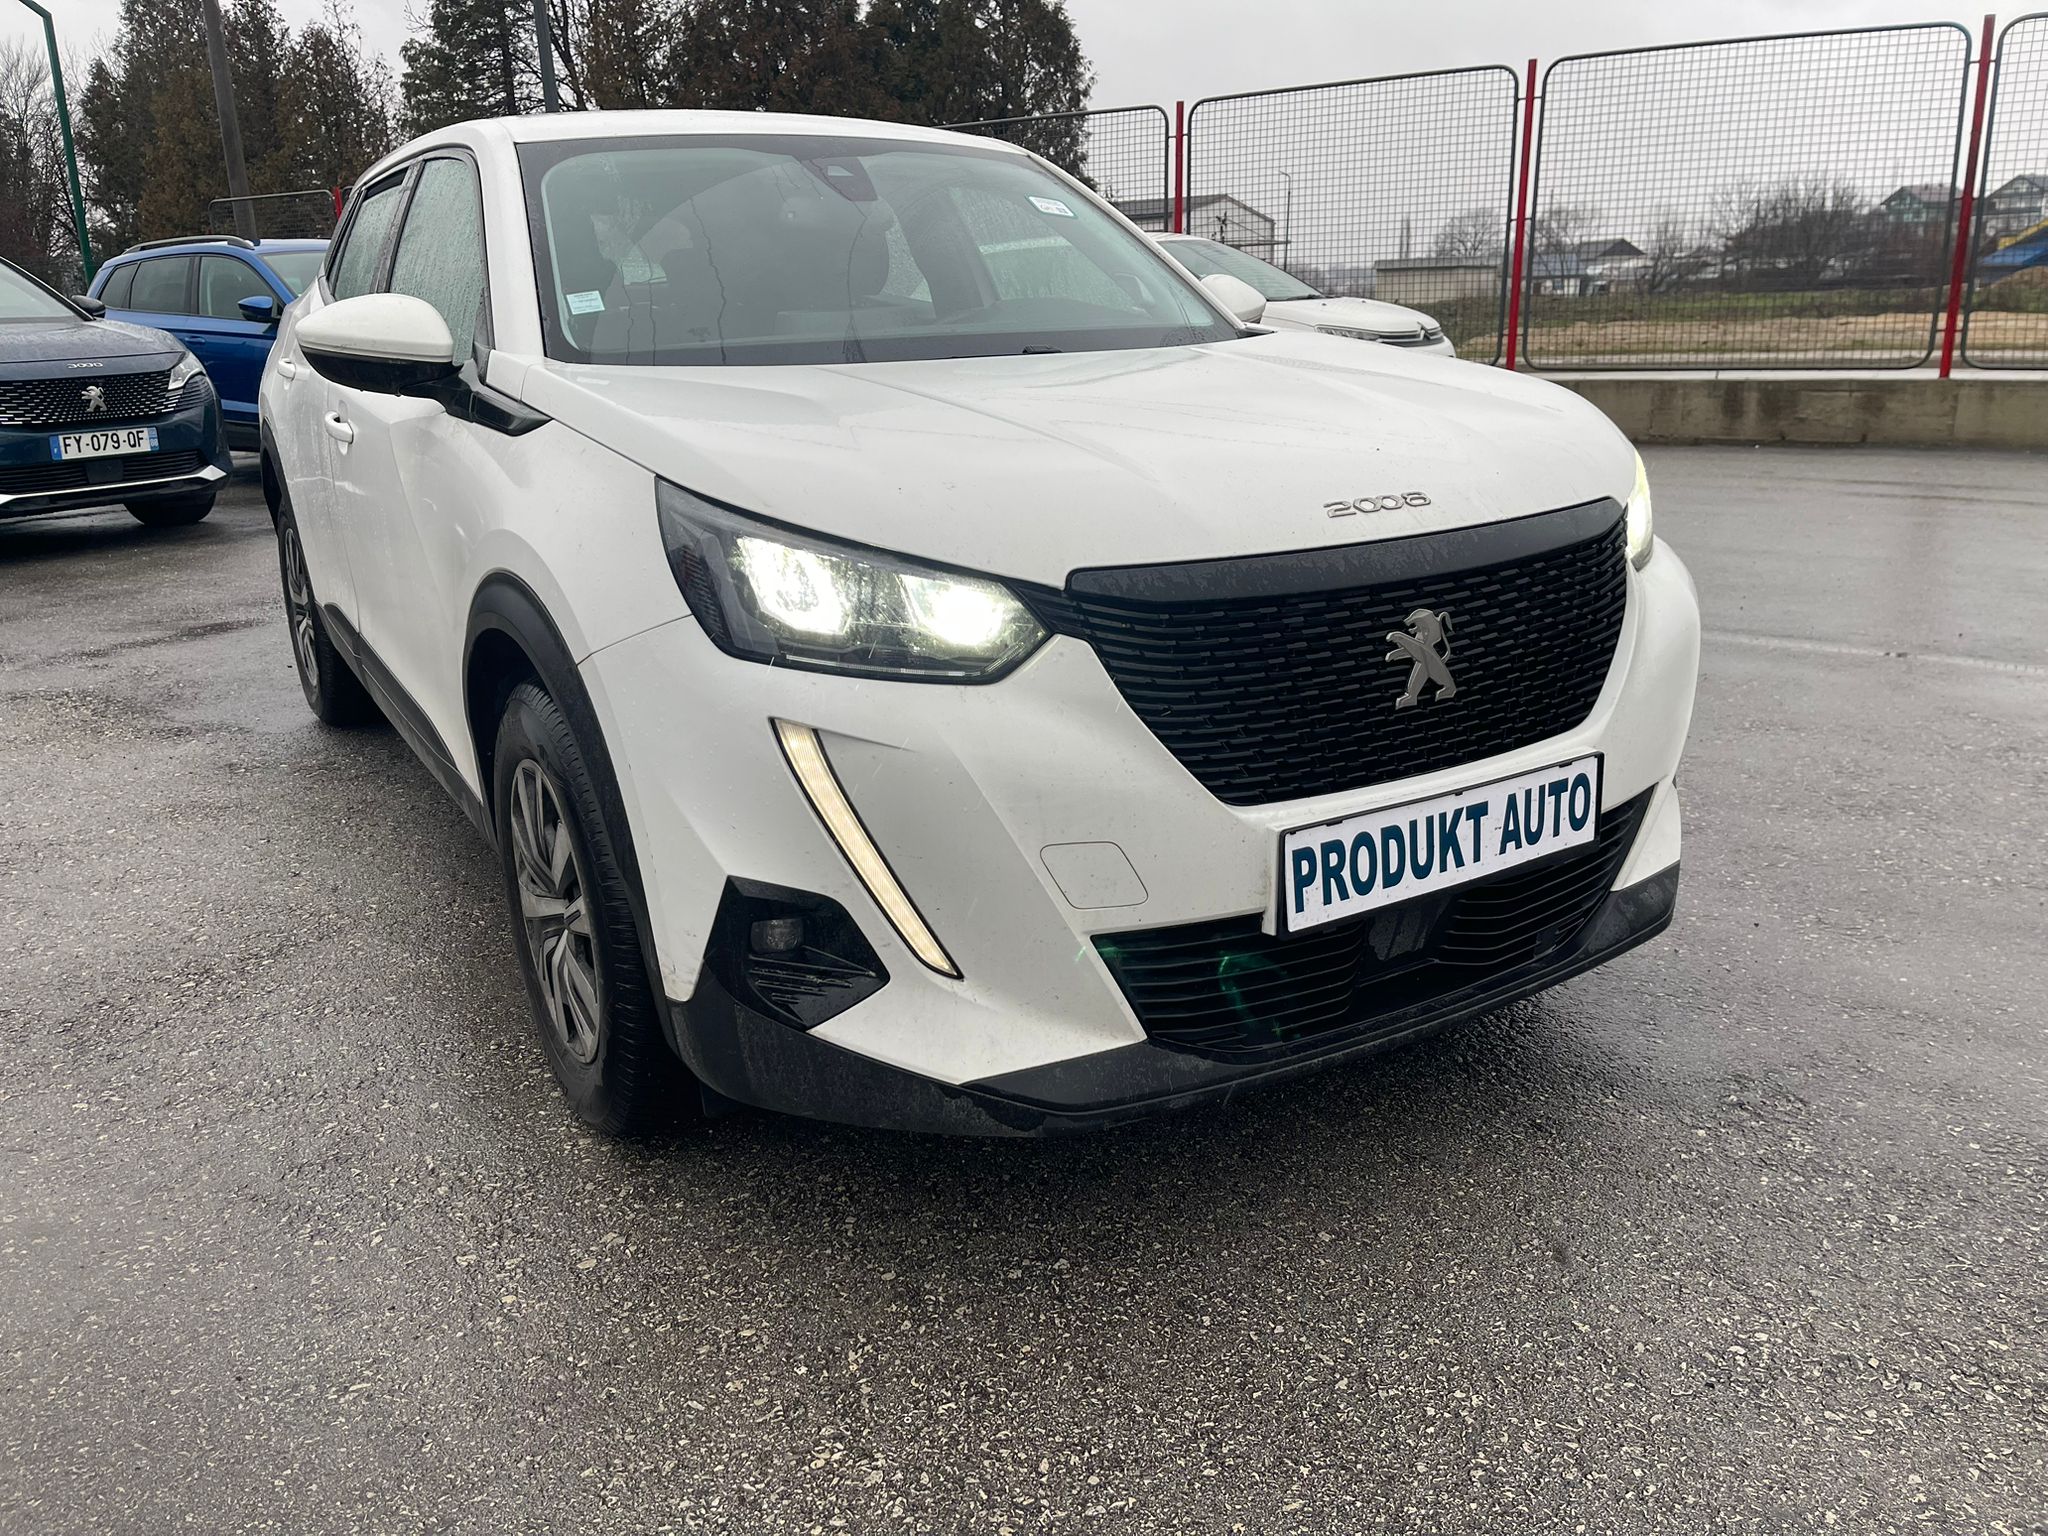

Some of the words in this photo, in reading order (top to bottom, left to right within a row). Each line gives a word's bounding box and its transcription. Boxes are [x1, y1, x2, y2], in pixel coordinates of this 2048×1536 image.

[62, 430, 145, 454] FY-079-QF
[1323, 491, 1431, 518] 2008
[1292, 801, 1489, 914] PRODUKT
[1499, 772, 1591, 855] AUTO
